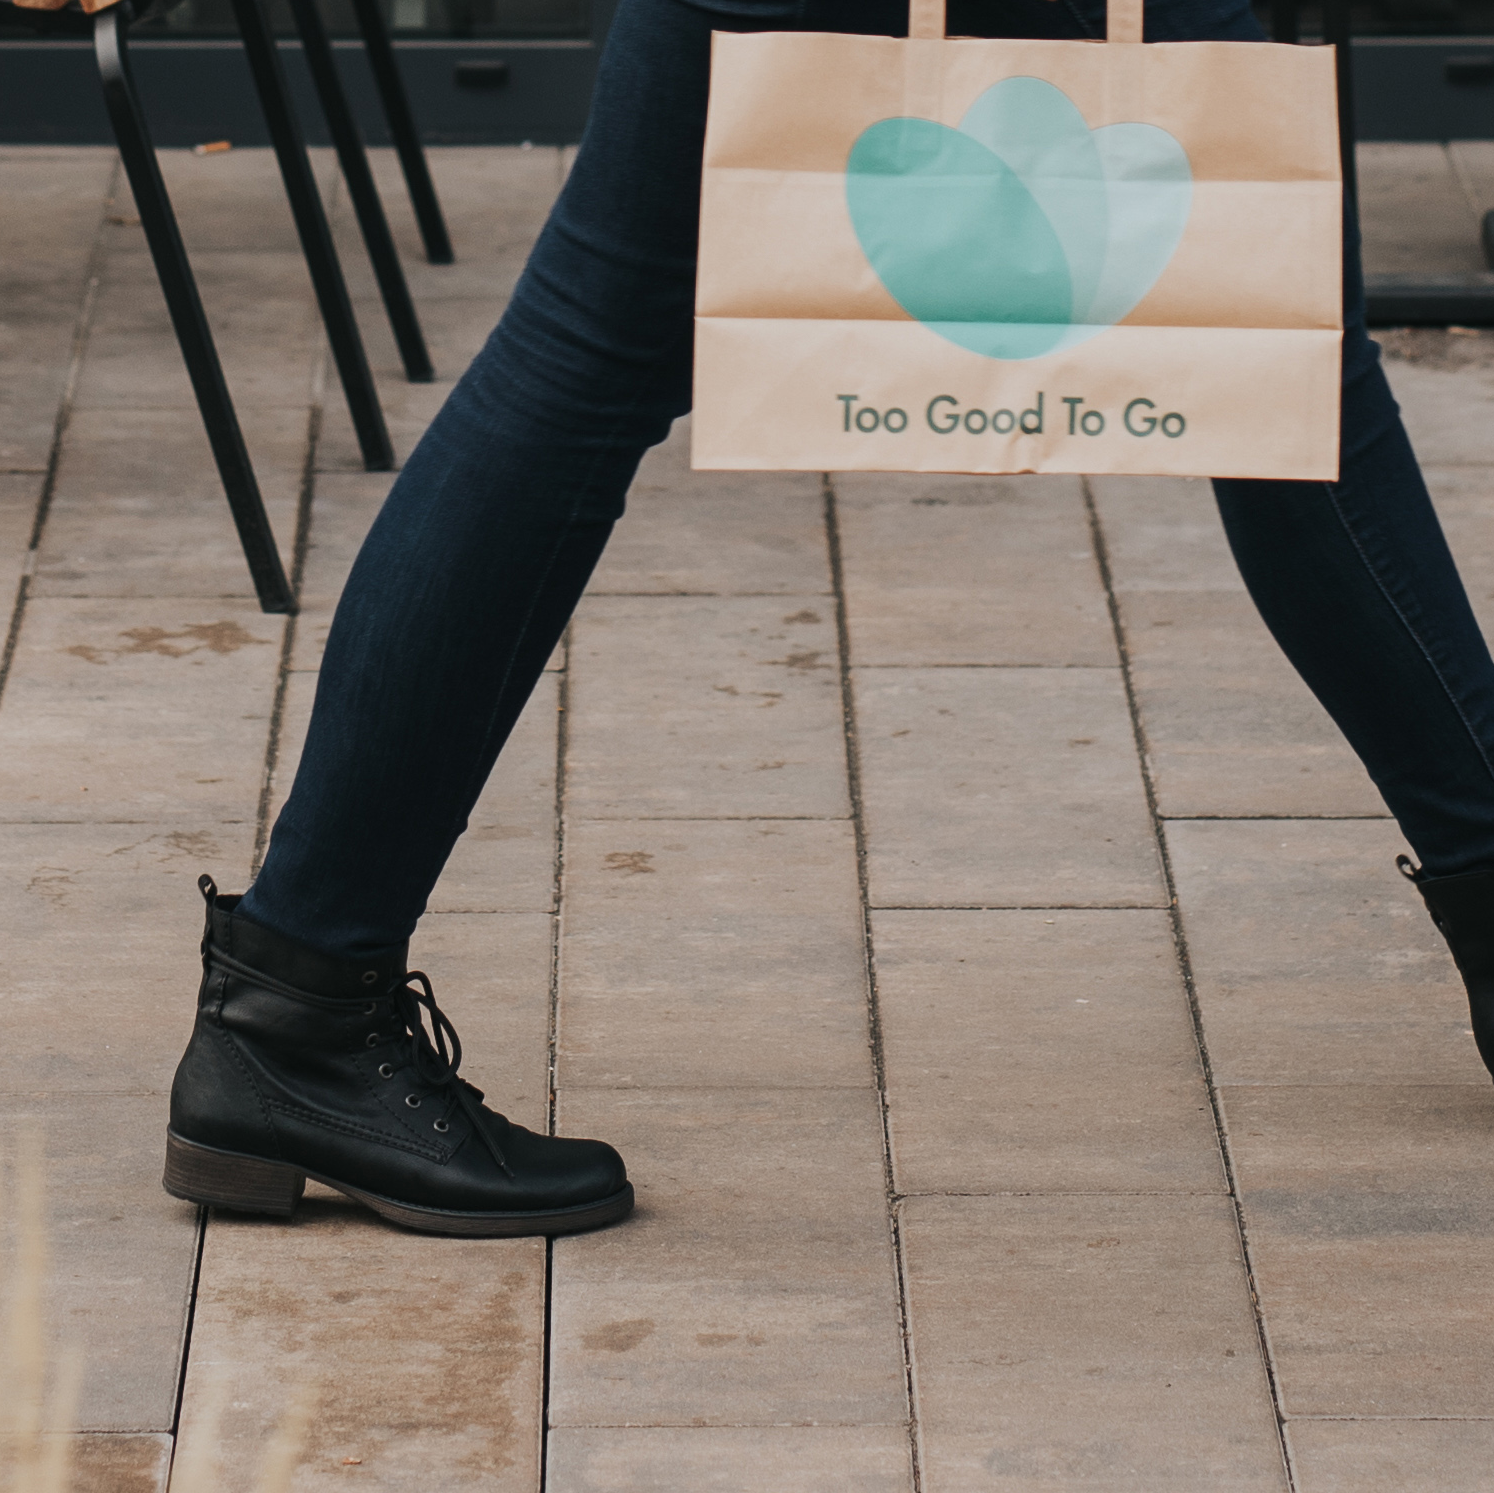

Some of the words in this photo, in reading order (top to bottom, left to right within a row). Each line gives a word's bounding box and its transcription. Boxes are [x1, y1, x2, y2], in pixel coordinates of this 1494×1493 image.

[836, 393, 909, 434] Too
[925, 390, 1045, 436] Good
[1061, 395, 1105, 437] To
[1122, 396, 1187, 439] Go
